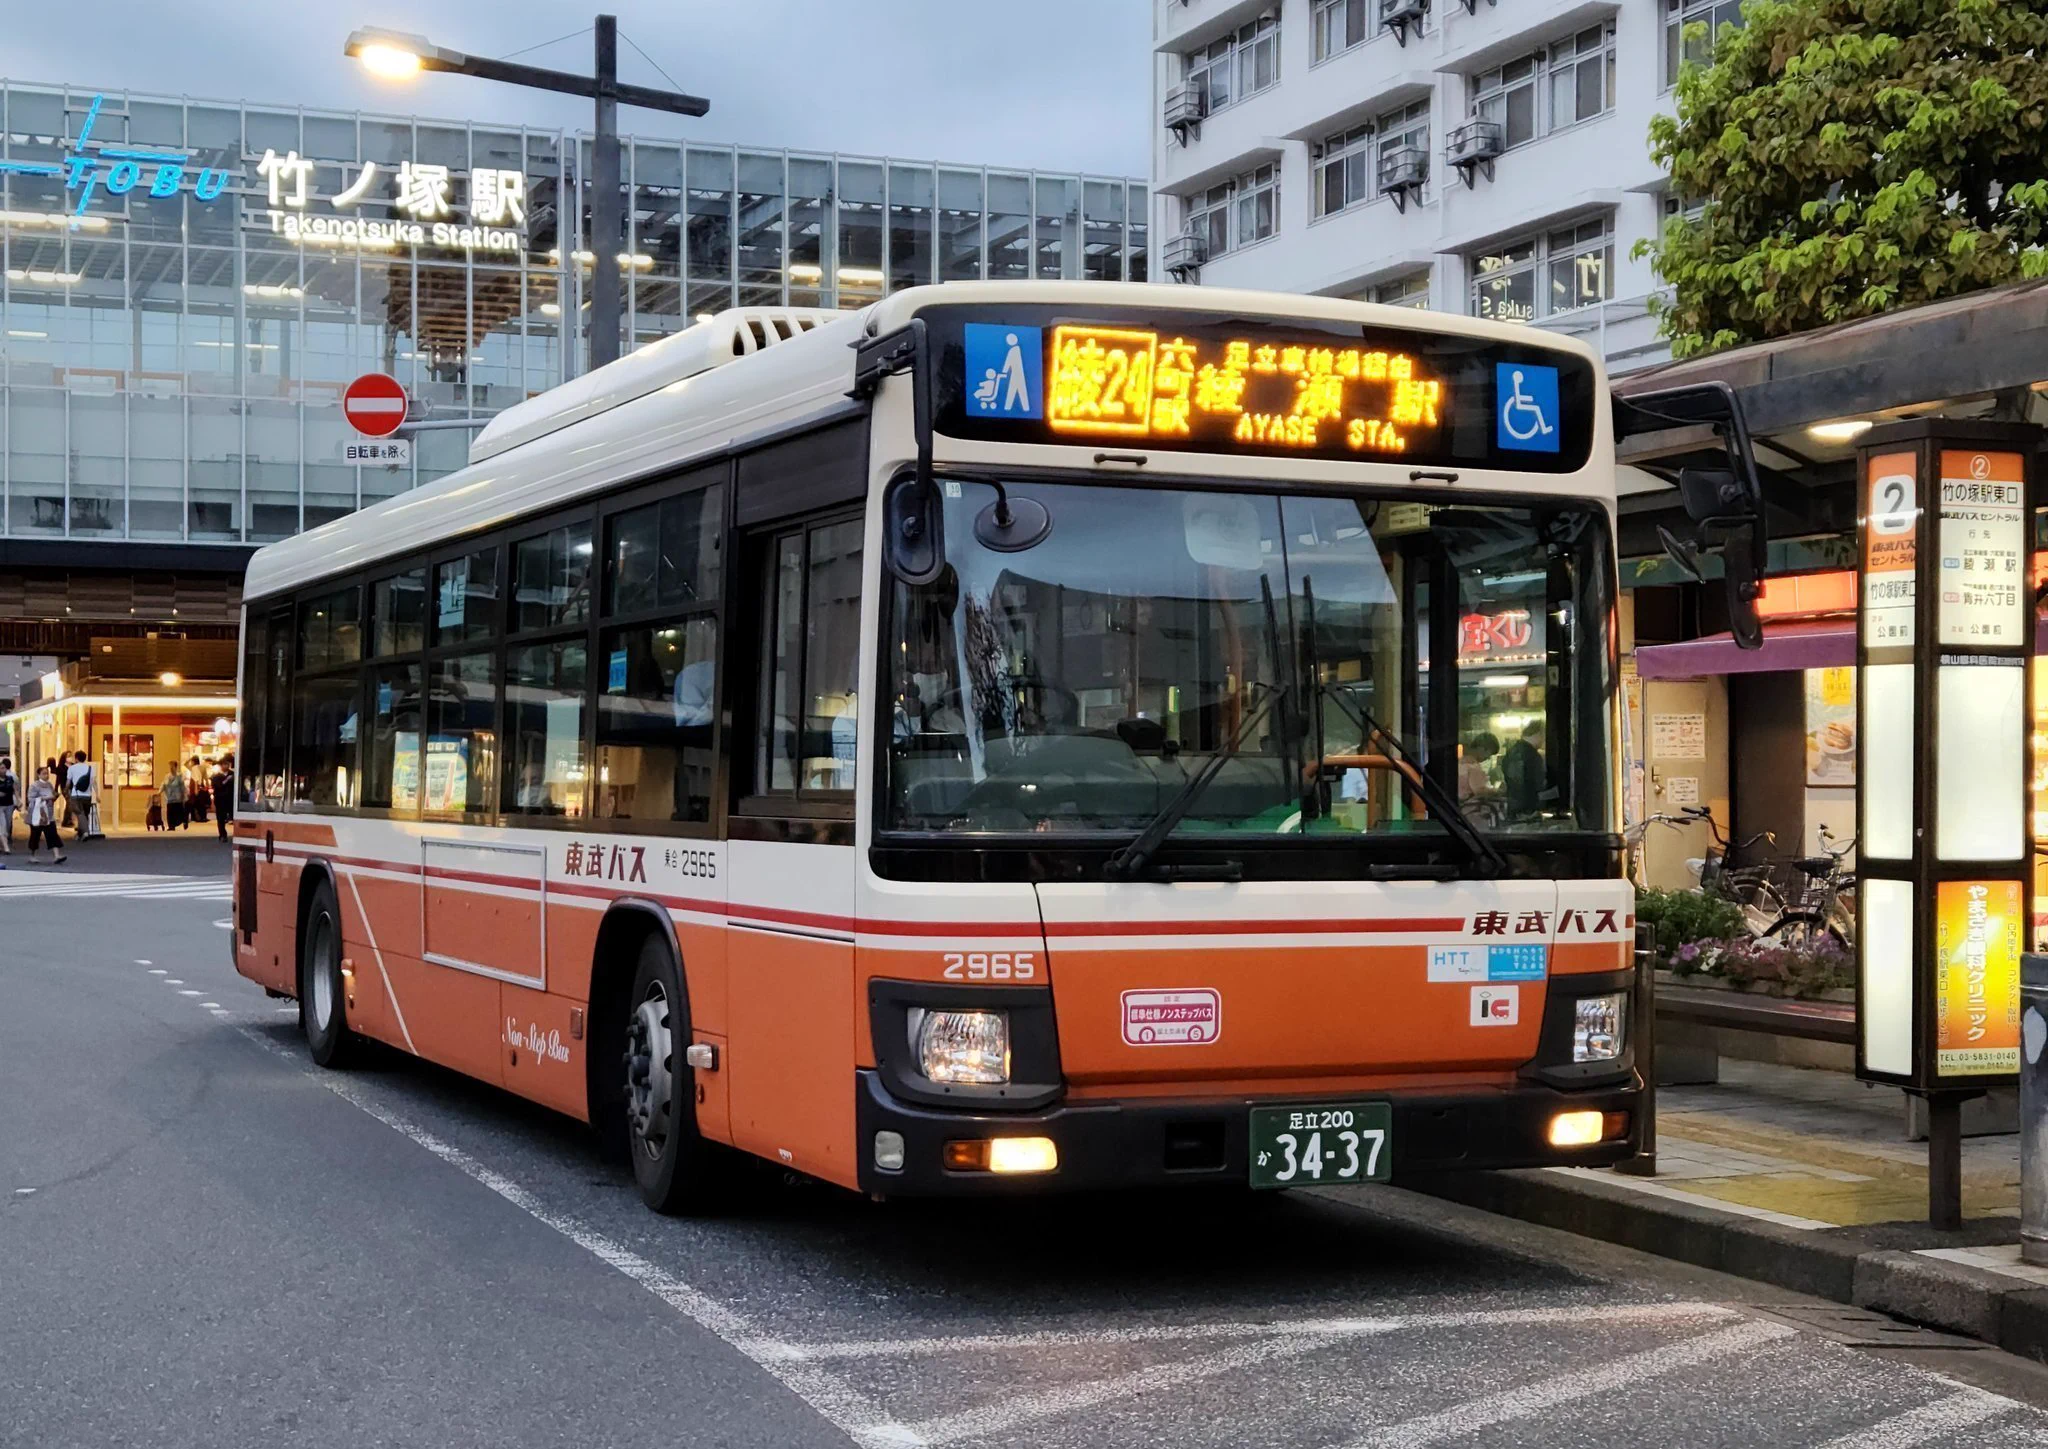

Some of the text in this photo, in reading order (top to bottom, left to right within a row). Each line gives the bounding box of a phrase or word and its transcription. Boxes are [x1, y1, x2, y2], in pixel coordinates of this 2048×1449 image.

[64, 156, 229, 201] TOBU
[256, 148, 525, 223] 竹ノ塚駅
[266, 208, 519, 250] Takenotsuka Station
[1055, 337, 1149, 419] 綾24
[346, 445, 407, 459] 自転車を除く
[1234, 412, 1406, 452] AYASE STA.
[1883, 481, 1906, 528] 2
[1943, 482, 2018, 504] 竹の塚駅東口
[565, 841, 647, 884] 東武バス
[682, 850, 716, 879] 2965
[1472, 908, 1619, 936] 東武バス
[943, 953, 1034, 979] 2965
[1434, 952, 1470, 965] HTT
[502, 1015, 570, 1065] Non-Step Bus
[1257, 1129, 1385, 1181] か 34-37
